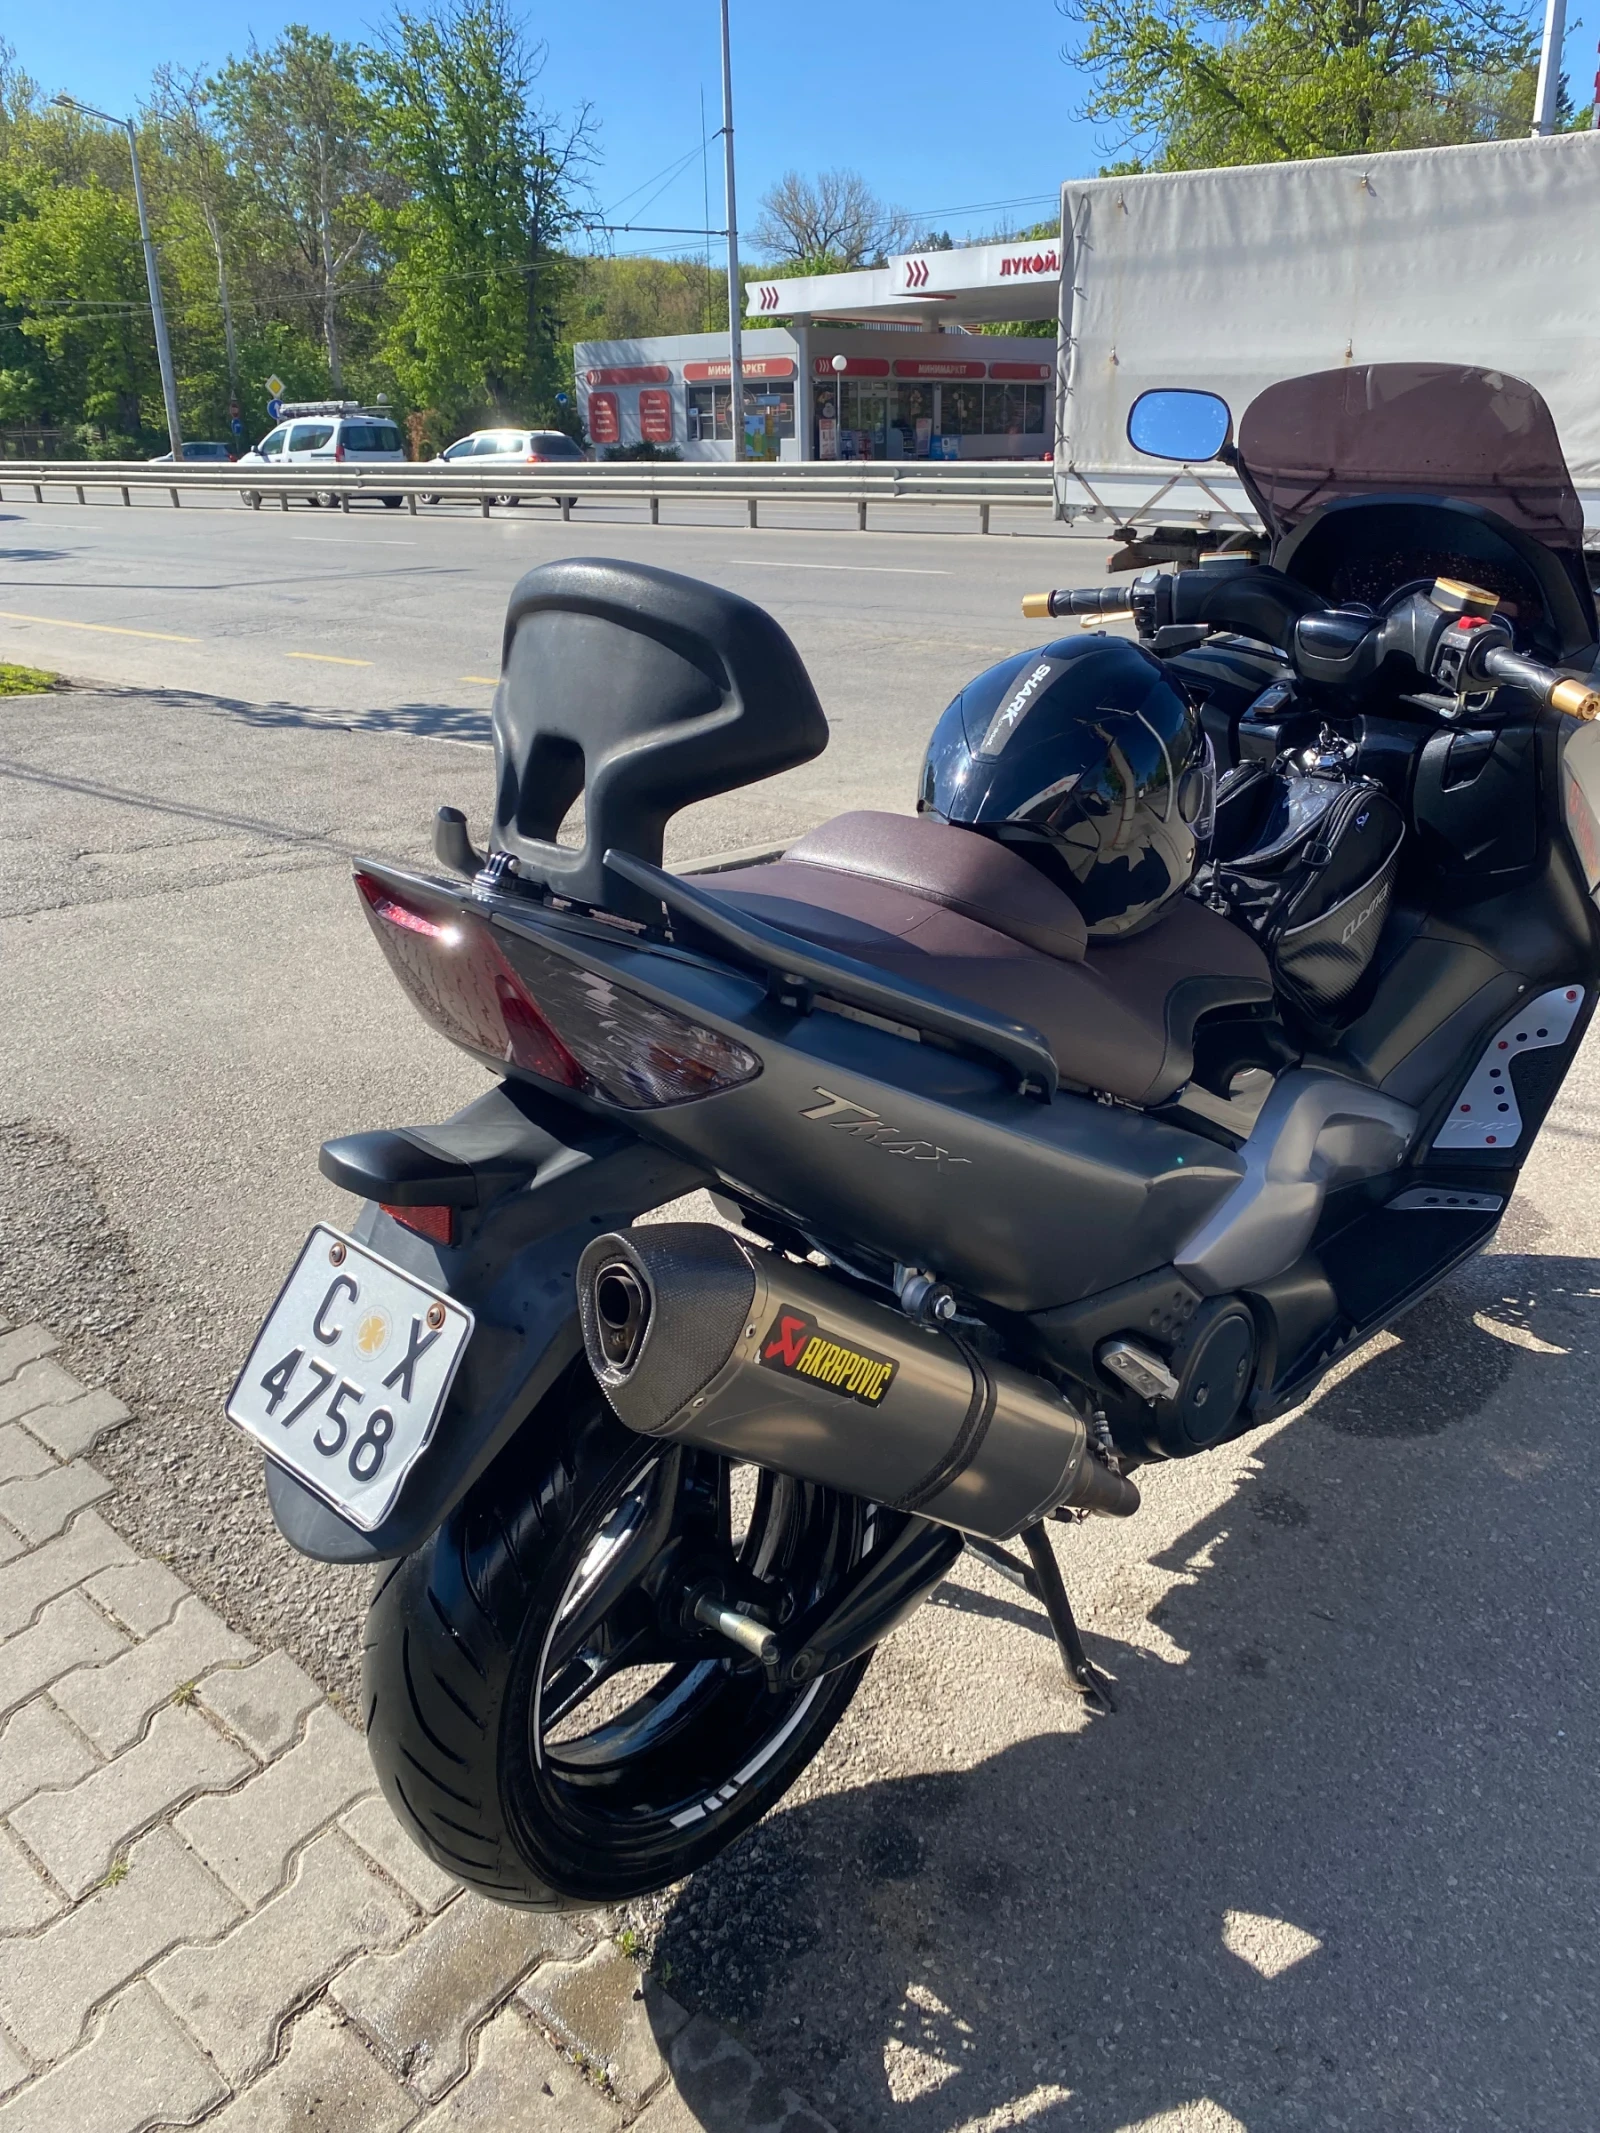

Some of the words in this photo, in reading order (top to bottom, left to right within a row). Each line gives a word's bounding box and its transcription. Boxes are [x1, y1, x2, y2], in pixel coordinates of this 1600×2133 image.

[708, 363, 767, 376] МИНИАРКЕТ
[918, 364, 967, 374] МИНИМАРКЕТ
[1001, 664, 1051, 727] SHARK
[259, 1345, 394, 1482] 4758
